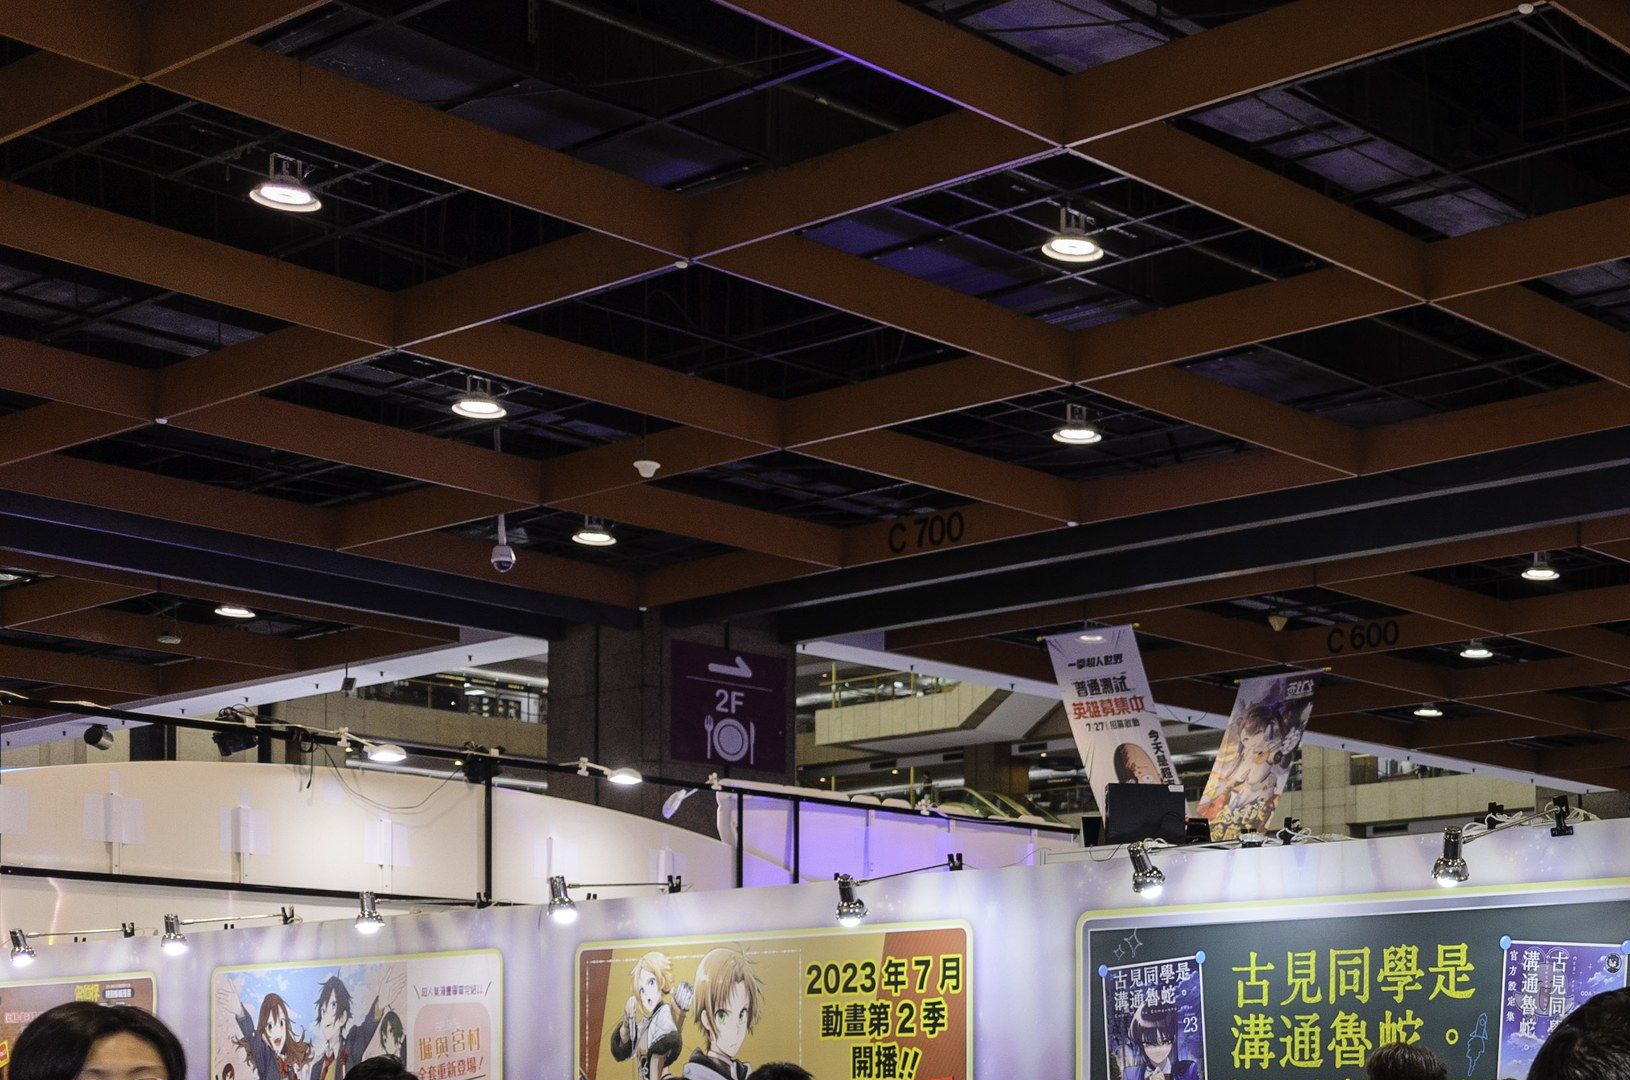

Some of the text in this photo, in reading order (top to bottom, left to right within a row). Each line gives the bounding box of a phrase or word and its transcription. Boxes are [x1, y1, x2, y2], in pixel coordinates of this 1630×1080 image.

[888, 511, 964, 553] C 700
[1327, 621, 1398, 653] C 600
[715, 689, 745, 714] 2F
[1072, 695, 1145, 719] 英雄募集中
[805, 954, 963, 996] 2023年7月
[1113, 962, 1191, 990] 古見同學是
[1231, 943, 1476, 1008] 古見同學是
[820, 999, 948, 1038] 動畫第2季
[1183, 1016, 1198, 1033] 23
